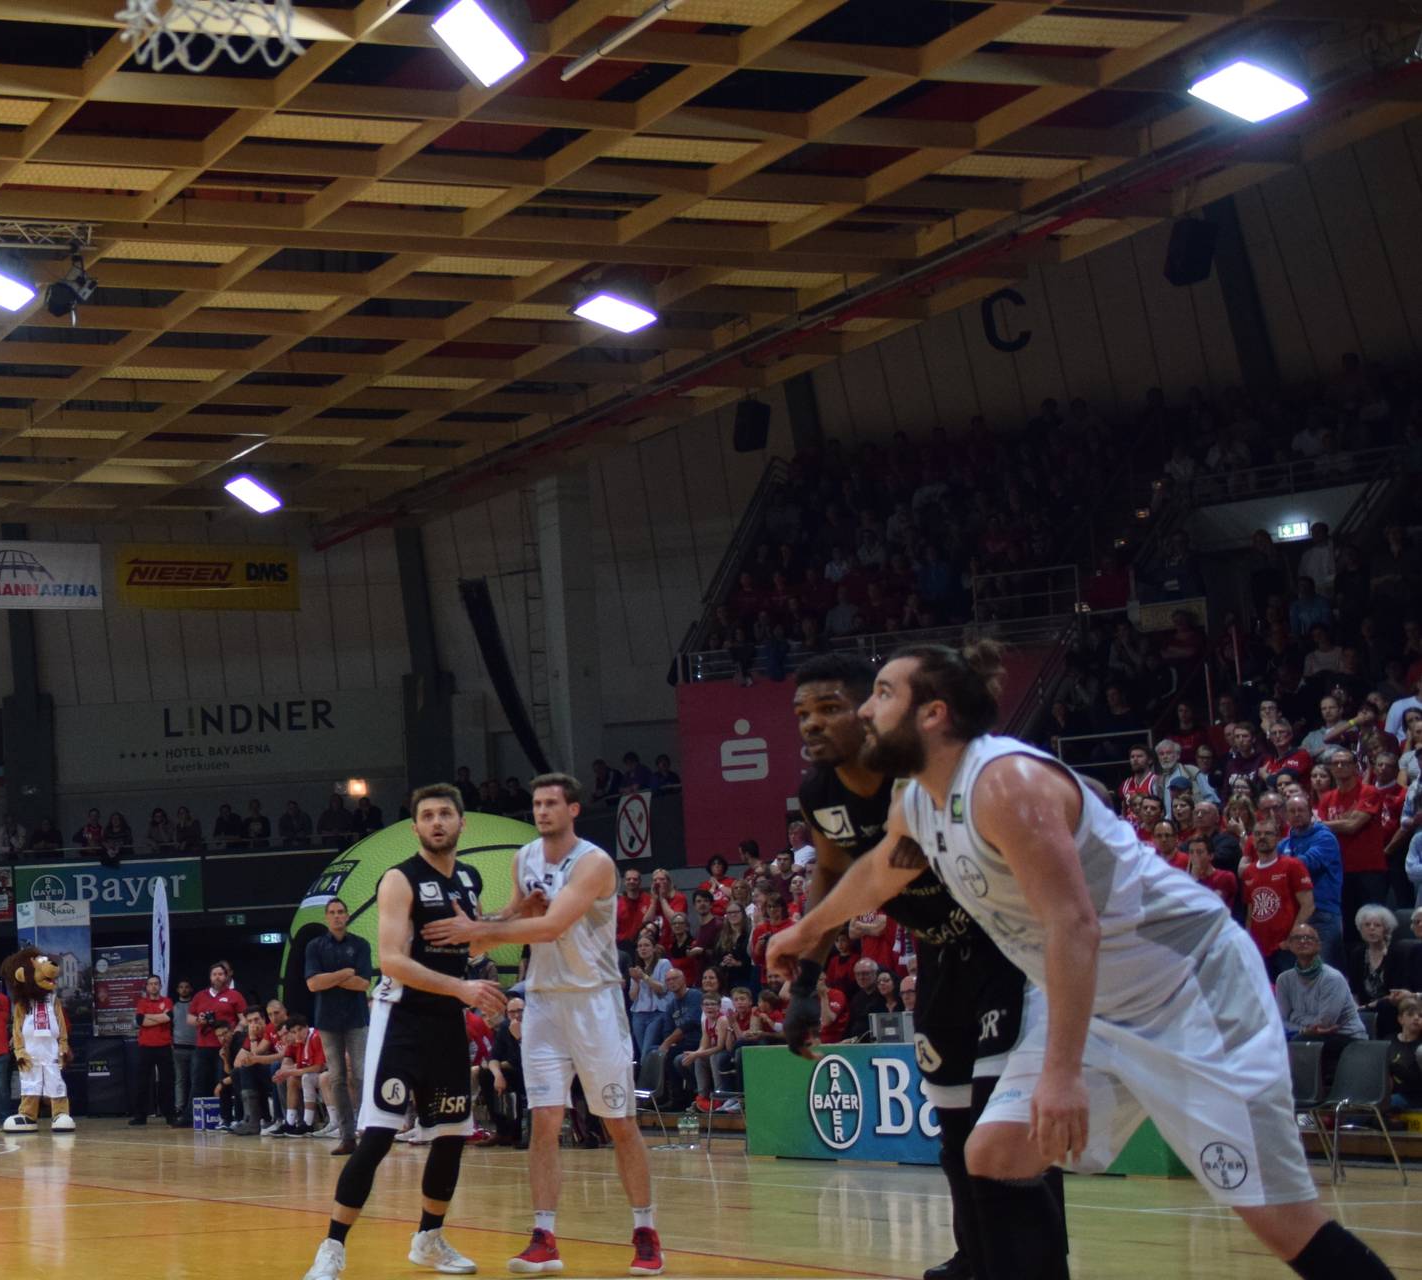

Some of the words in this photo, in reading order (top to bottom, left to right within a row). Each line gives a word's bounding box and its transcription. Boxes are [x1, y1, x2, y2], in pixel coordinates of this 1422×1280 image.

[982, 289, 1032, 352] C
[129, 565, 230, 581] NIESEN
[246, 563, 288, 582] DMS
[166, 747, 203, 759] HOTEL
[208, 744, 271, 758] BAYARENA
[165, 760, 230, 773] Leverkusen
[439, 1095, 466, 1114] ISR
[813, 1094, 859, 1109] BAYER
[829, 1063, 844, 1142] BAYER
